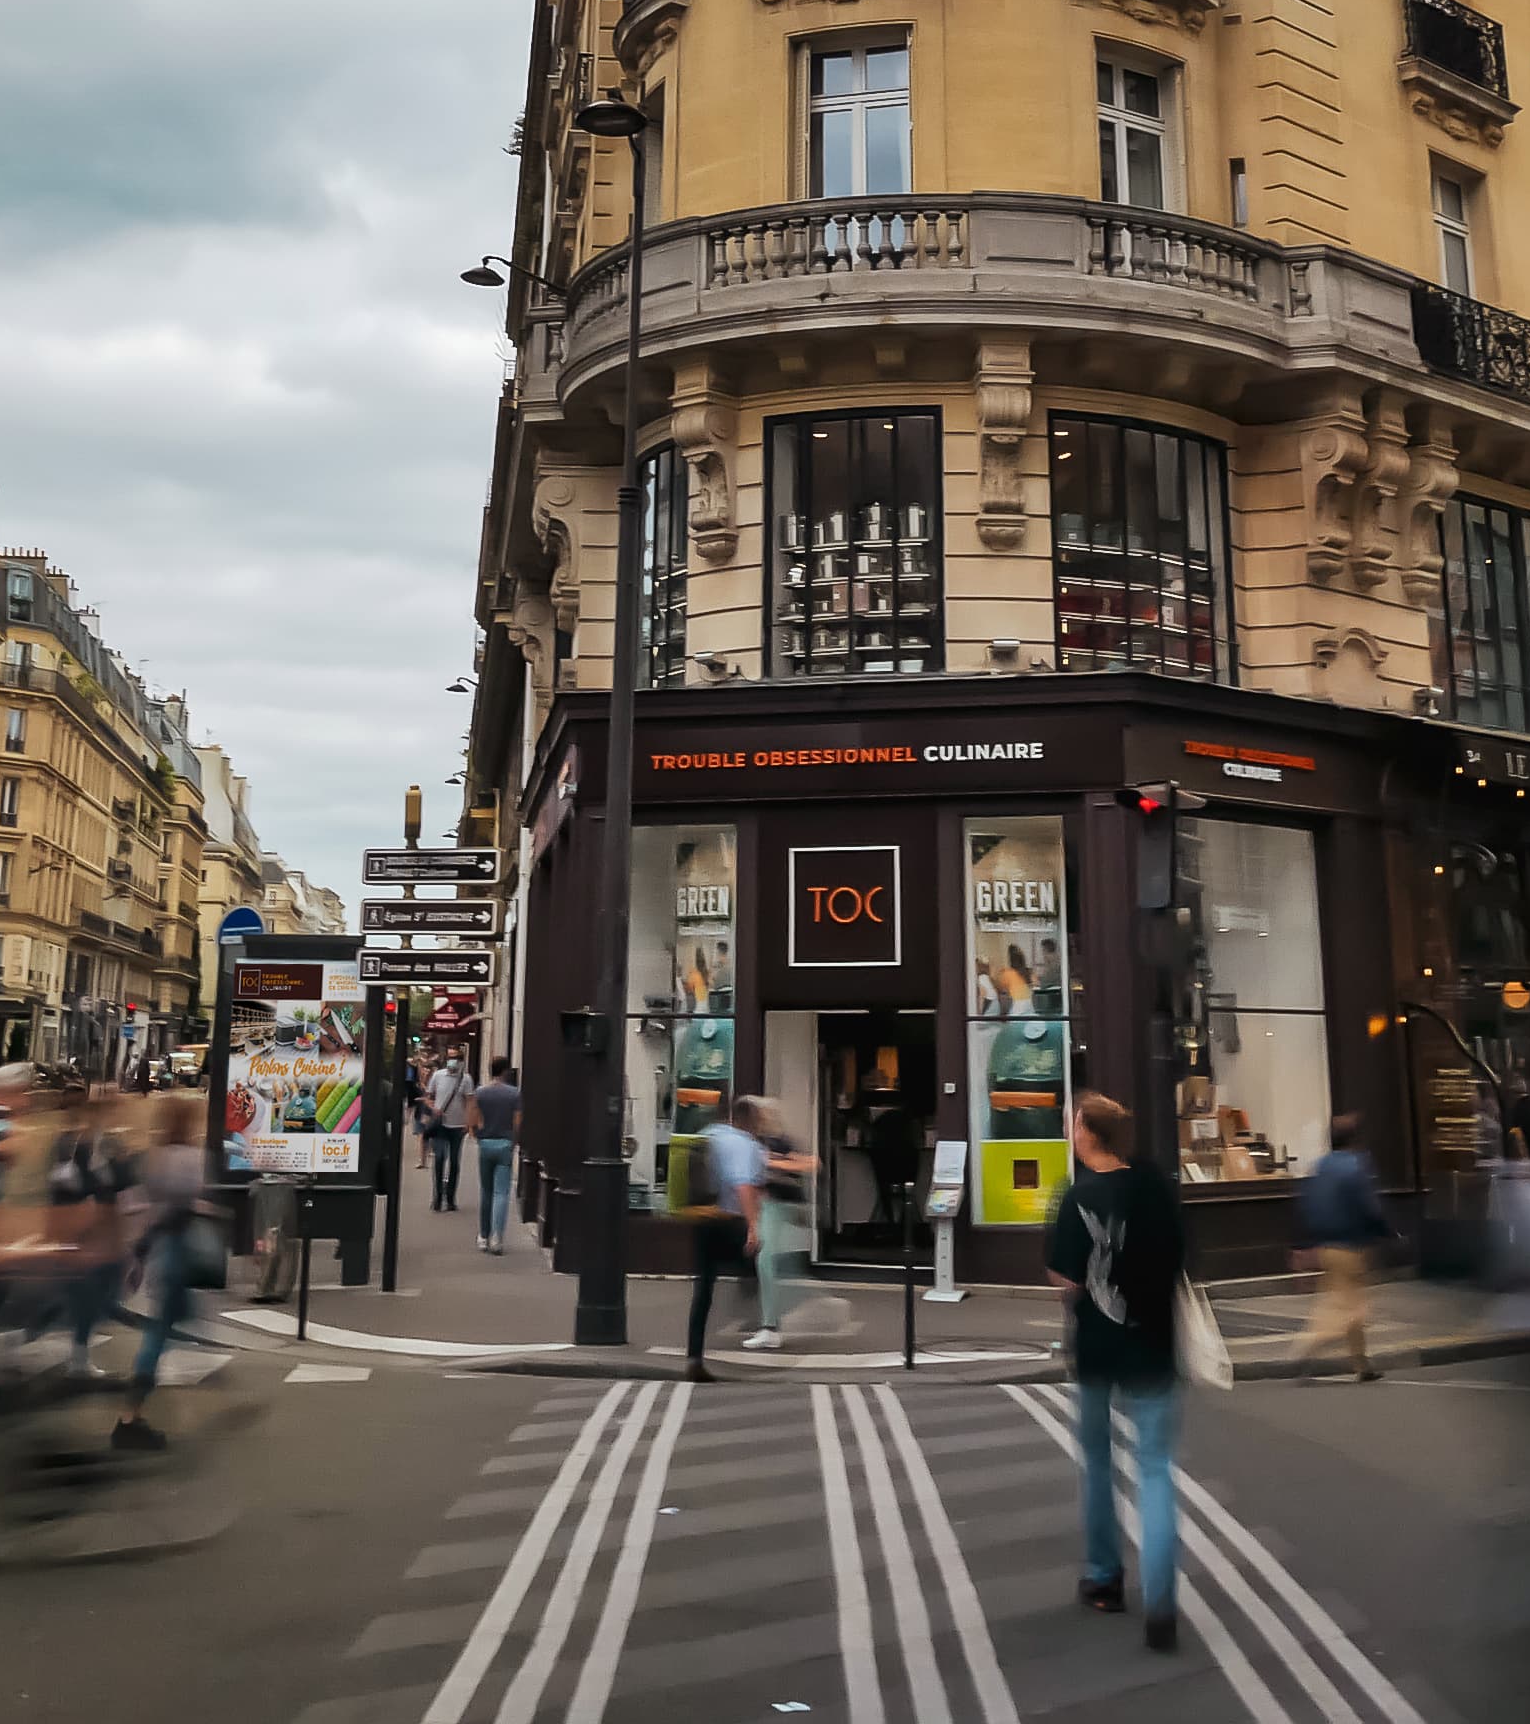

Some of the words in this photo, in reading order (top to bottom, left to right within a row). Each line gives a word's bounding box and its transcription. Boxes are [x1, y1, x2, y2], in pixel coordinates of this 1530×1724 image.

[651, 753, 747, 770] TROUBLE
[753, 746, 917, 766] OBSESSIONNEL
[923, 742, 1044, 762] CULINAIRE
[1505, 752, 1529, 779] LE
[806, 886, 884, 923] TOC
[976, 880, 1055, 912] GREEN
[249, 1056, 289, 1077] Parlons
[292, 1057, 337, 1077] Cuisine
[322, 1144, 350, 1156] toc.fr
